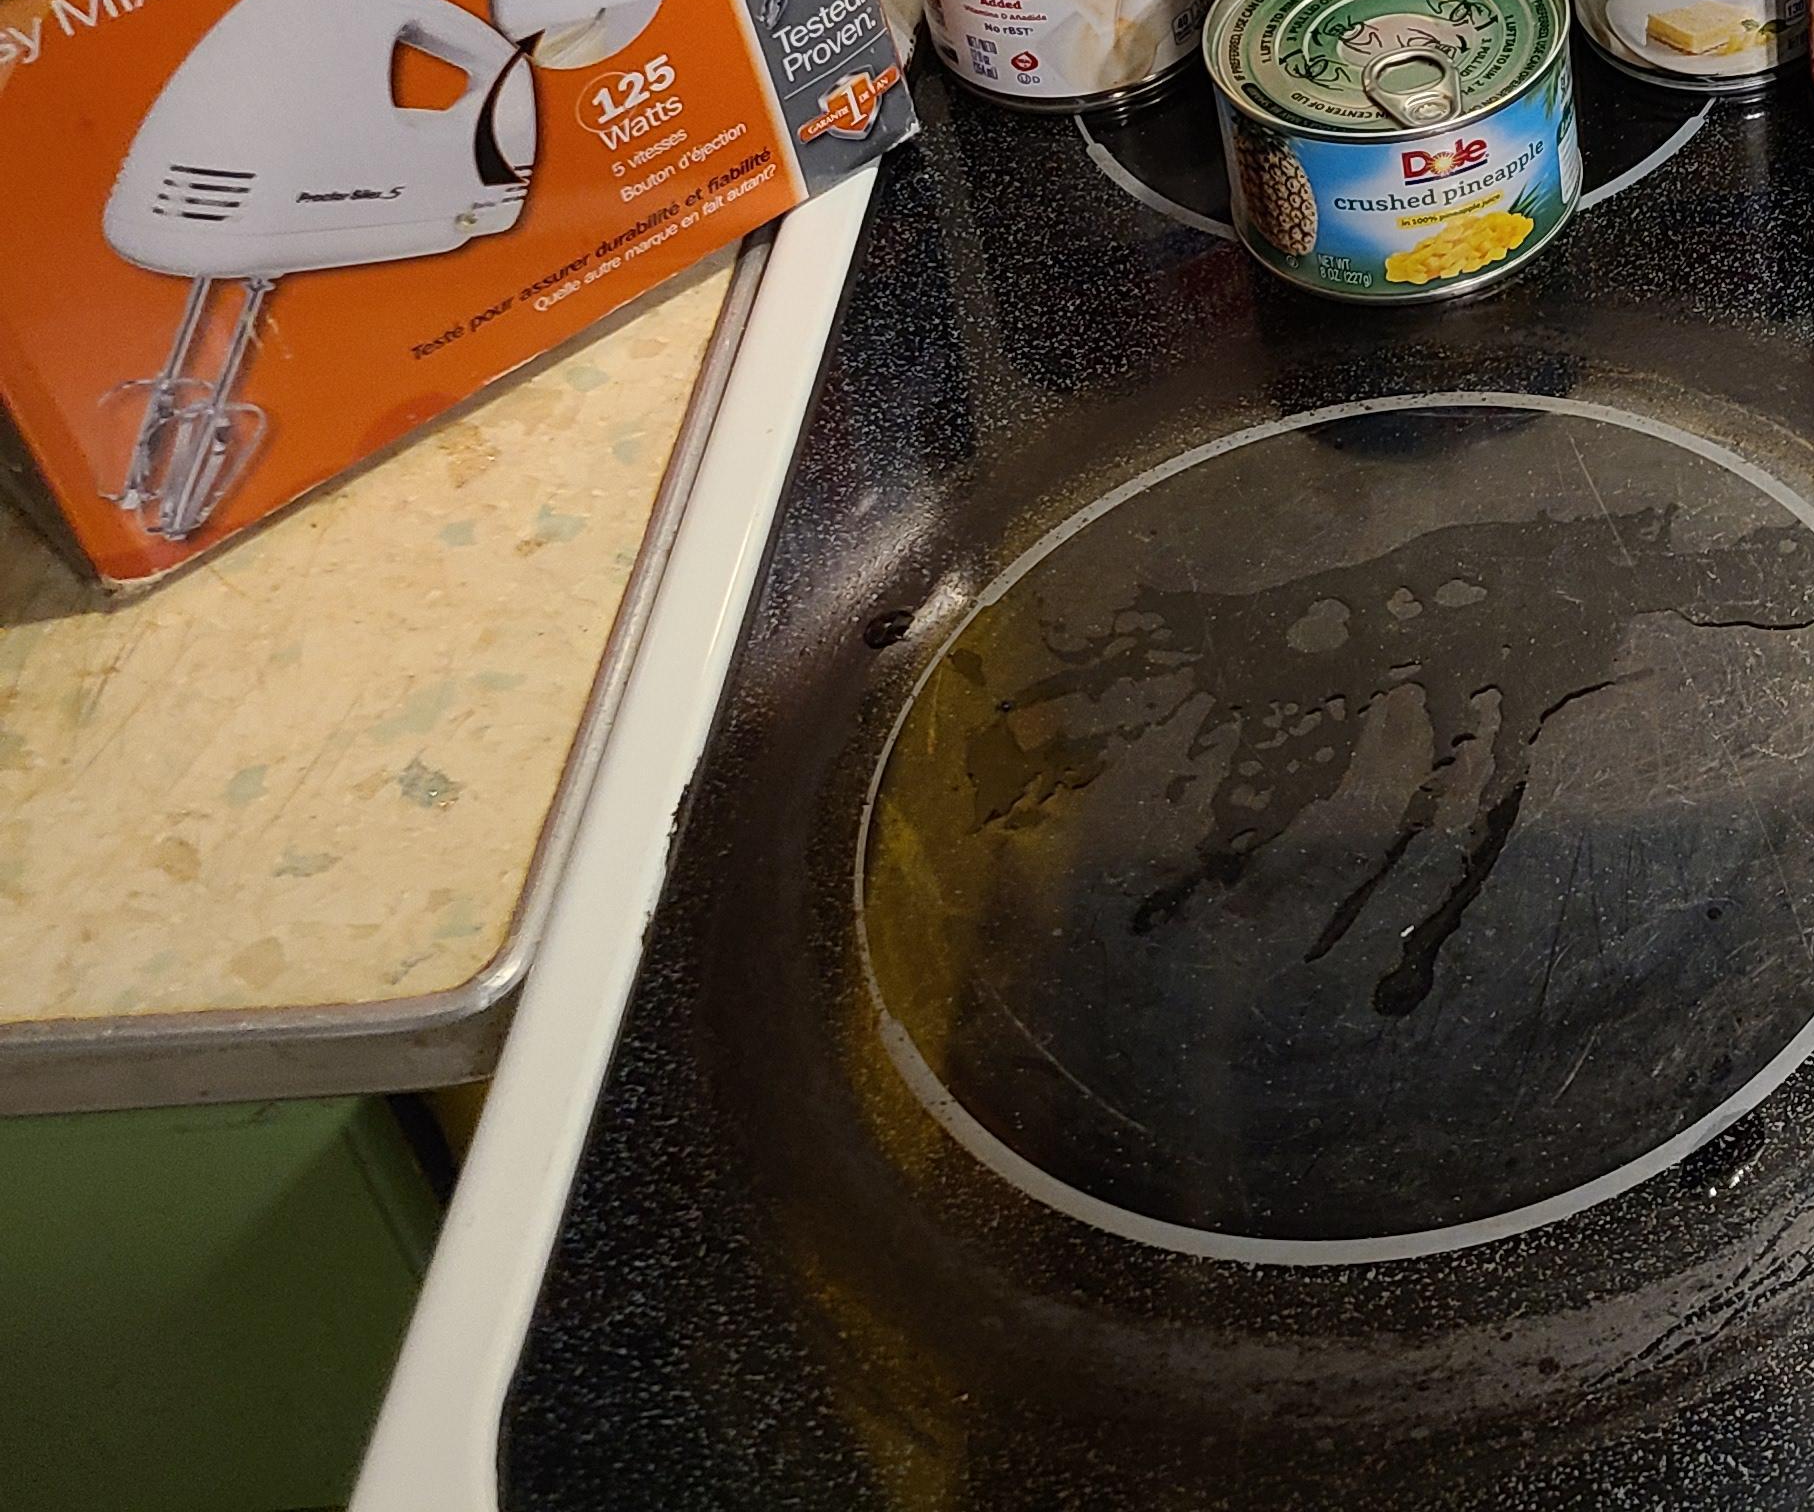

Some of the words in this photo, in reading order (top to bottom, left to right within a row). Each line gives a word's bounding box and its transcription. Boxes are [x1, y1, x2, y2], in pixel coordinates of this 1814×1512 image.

[782, 7, 877, 82] Proven.
[591, 54, 676, 124] 125
[599, 95, 683, 150] Watts
[611, 161, 626, 177] 5
[627, 128, 688, 169] vitesses
[619, 164, 676, 203] Bouton
[1333, 188, 1436, 213] crushed
[1442, 140, 1544, 204] pineapple
[1400, 138, 1489, 179] Dole
[469, 296, 514, 333] pour
[519, 253, 591, 302] assurer
[595, 201, 680, 259] durabilité
[533, 278, 582, 313] Quelle
[583, 255, 622, 285] autre
[623, 222, 678, 262] marque
[680, 210, 701, 230] en
[726, 163, 777, 202] autant?
